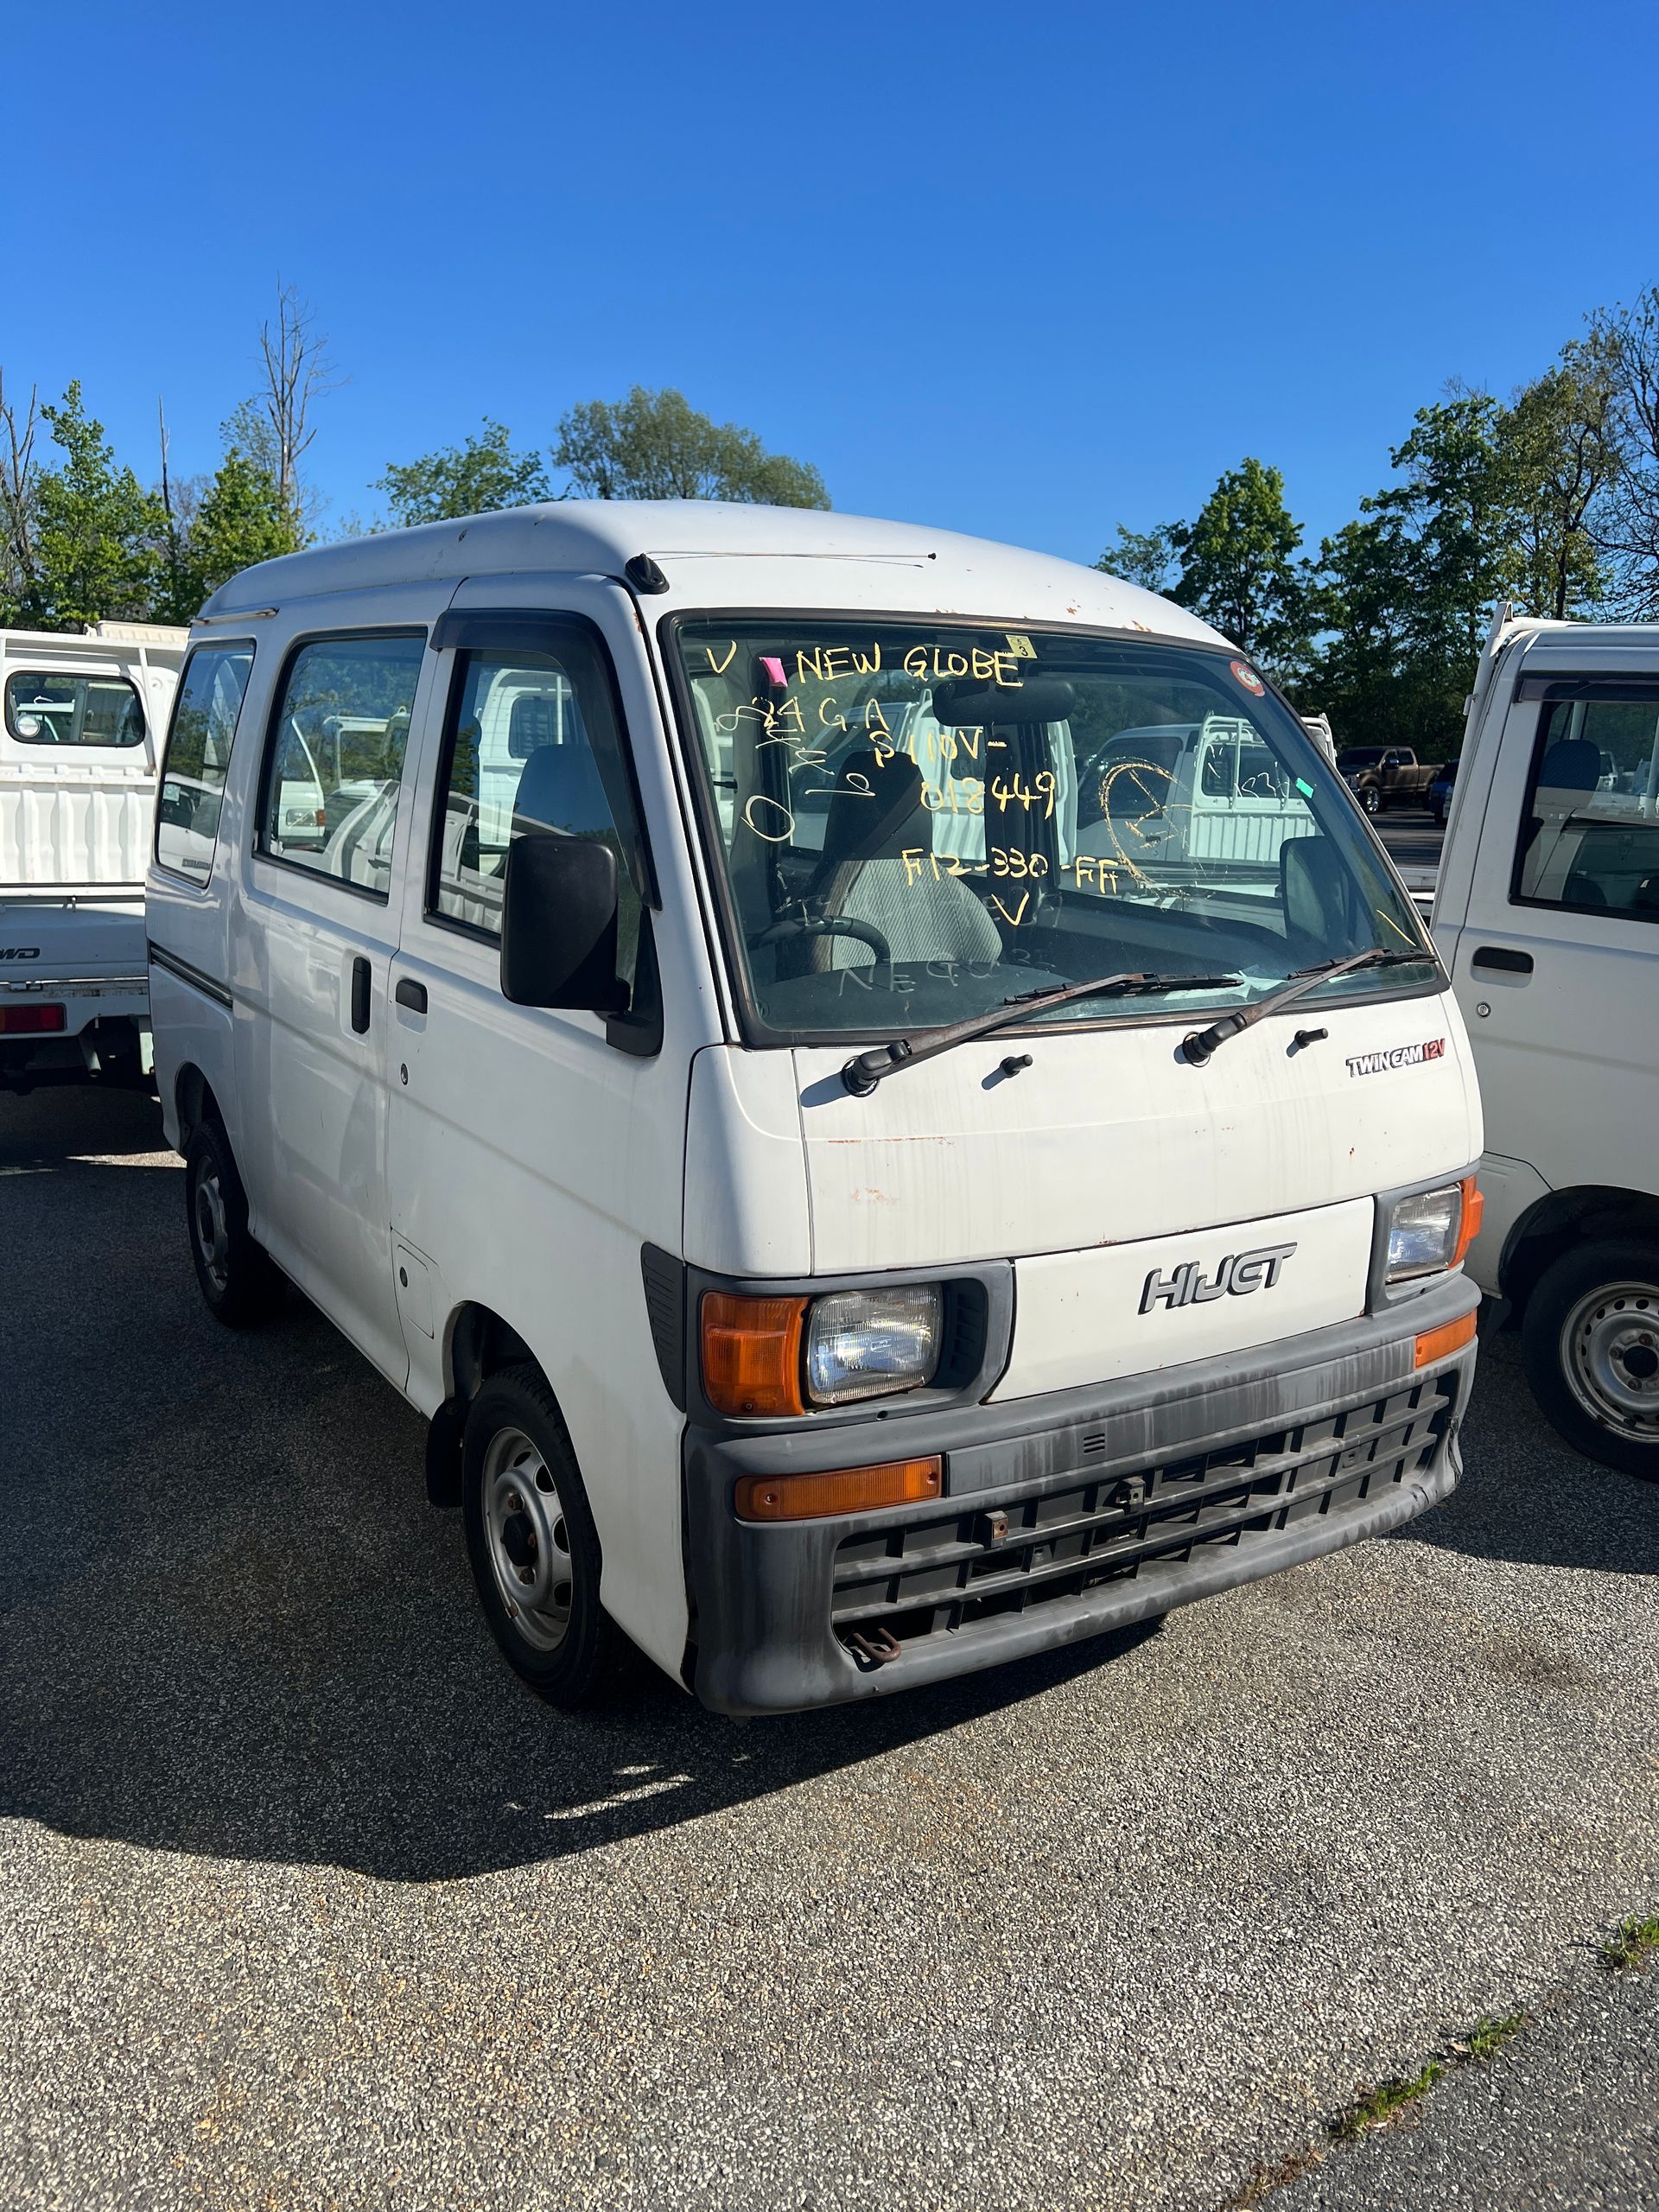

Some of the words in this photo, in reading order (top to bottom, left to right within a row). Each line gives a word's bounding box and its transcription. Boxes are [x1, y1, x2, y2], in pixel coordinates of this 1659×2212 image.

[796, 642, 881, 683] NEW
[903, 646, 1024, 687] GLOBE
[1019, 645, 1029, 657] 3
[920, 771, 1056, 820] 018449
[1138, 1242, 1298, 1315] HIJET
